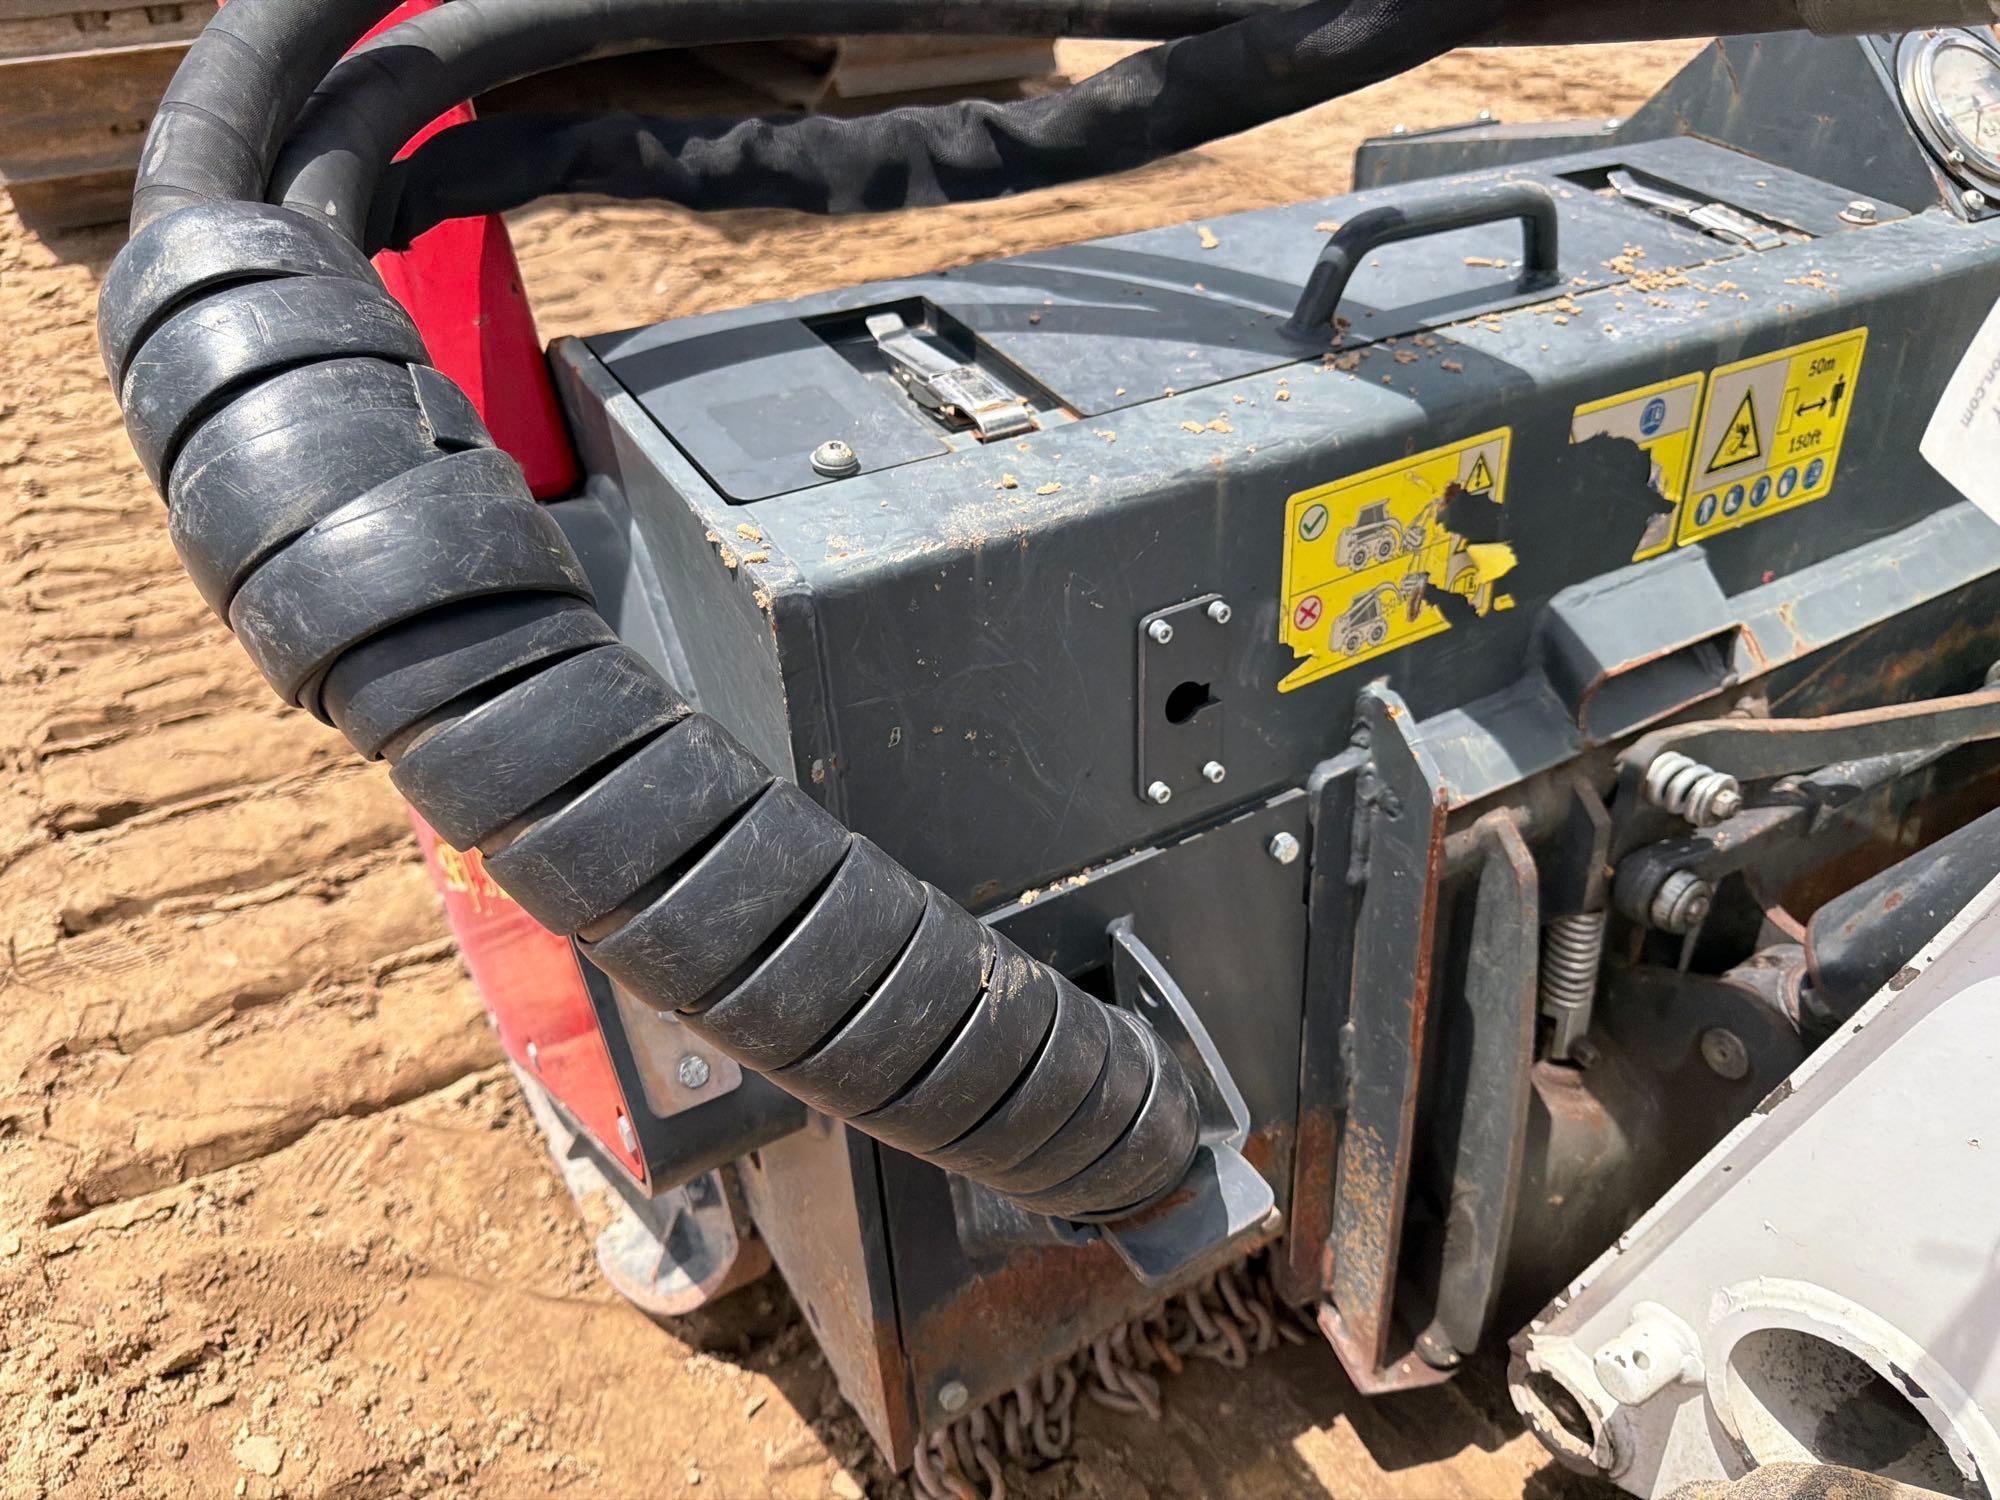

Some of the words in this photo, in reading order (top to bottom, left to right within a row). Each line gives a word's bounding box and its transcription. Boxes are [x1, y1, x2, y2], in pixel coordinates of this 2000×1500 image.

[1808, 357, 1836, 377] 50m
[1960, 350, 2000, 428] on.com
[1788, 428, 1822, 454] 150ft
